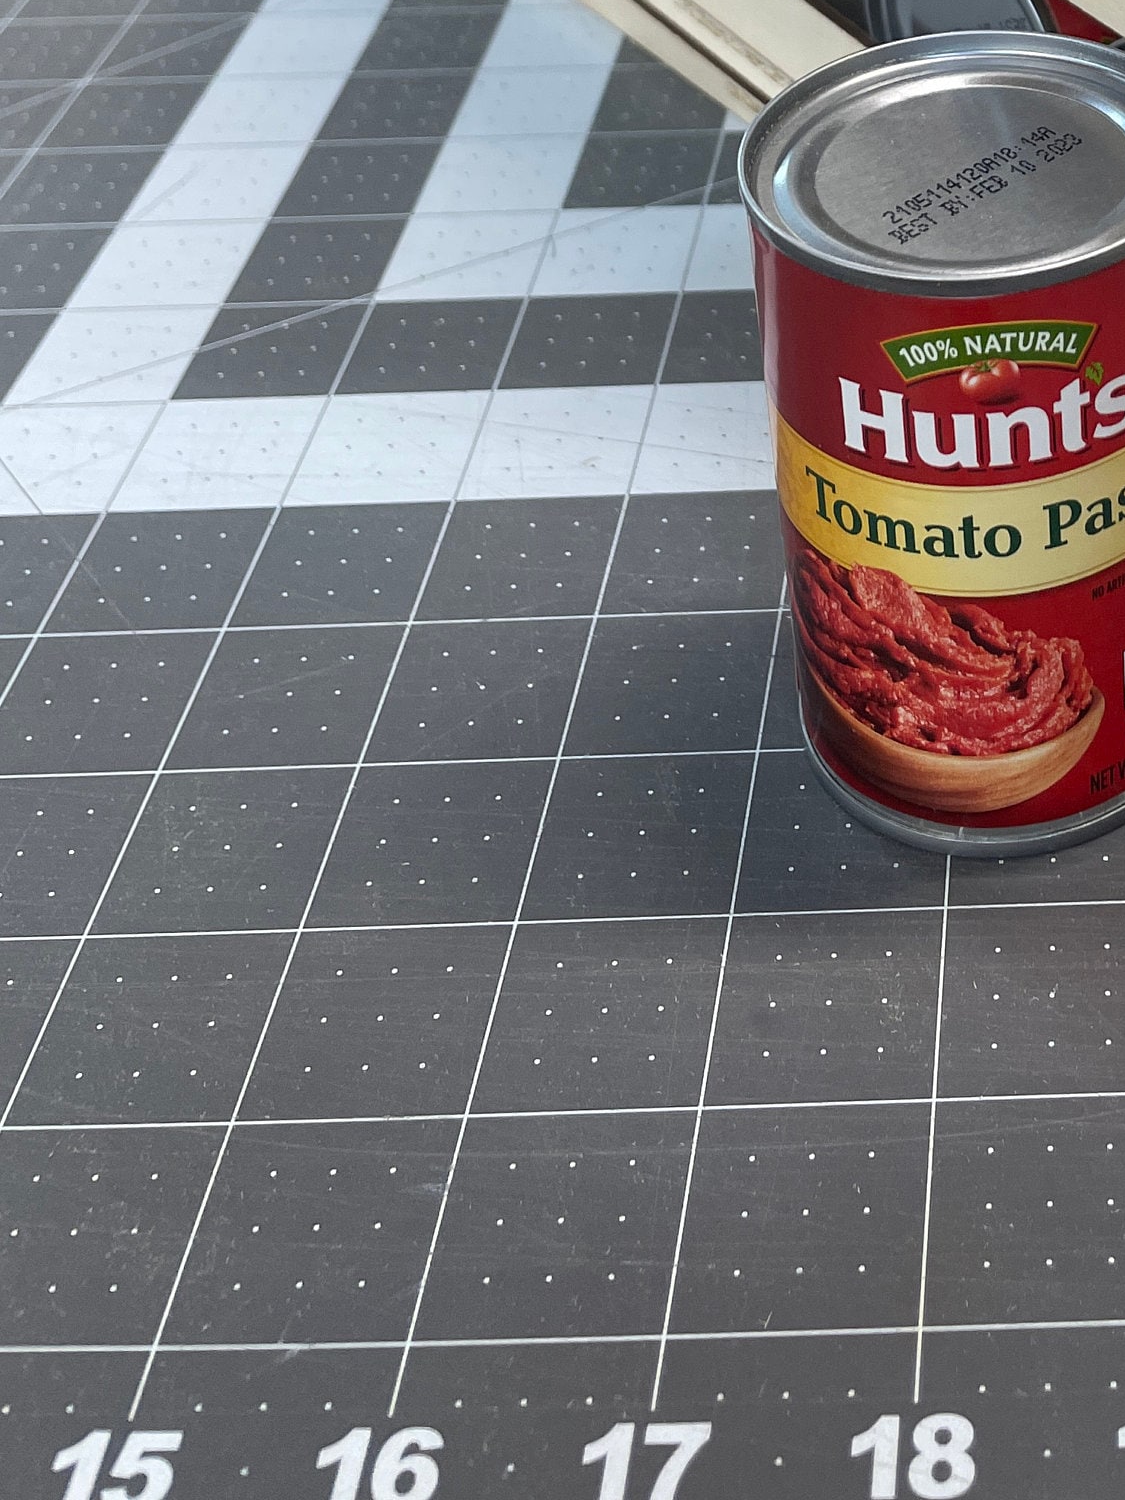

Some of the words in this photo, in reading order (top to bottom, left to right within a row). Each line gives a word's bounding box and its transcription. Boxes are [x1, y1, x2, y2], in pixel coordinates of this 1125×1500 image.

[888, 212, 939, 245] BEST
[946, 175, 1010, 218] BY:FEB
[1010, 158, 1037, 179] 10
[1036, 132, 1084, 164] 2023
[899, 338, 958, 368] 100%
[963, 331, 1080, 357] NATURAL
[805, 466, 1022, 559] Tomato
[1091, 585, 1105, 602] NO
[1090, 766, 1115, 795] NET
[52, 1429, 182, 1500] 15
[315, 1426, 443, 1500] 16
[582, 1422, 712, 1500] 17
[850, 1412, 976, 1500] 18
